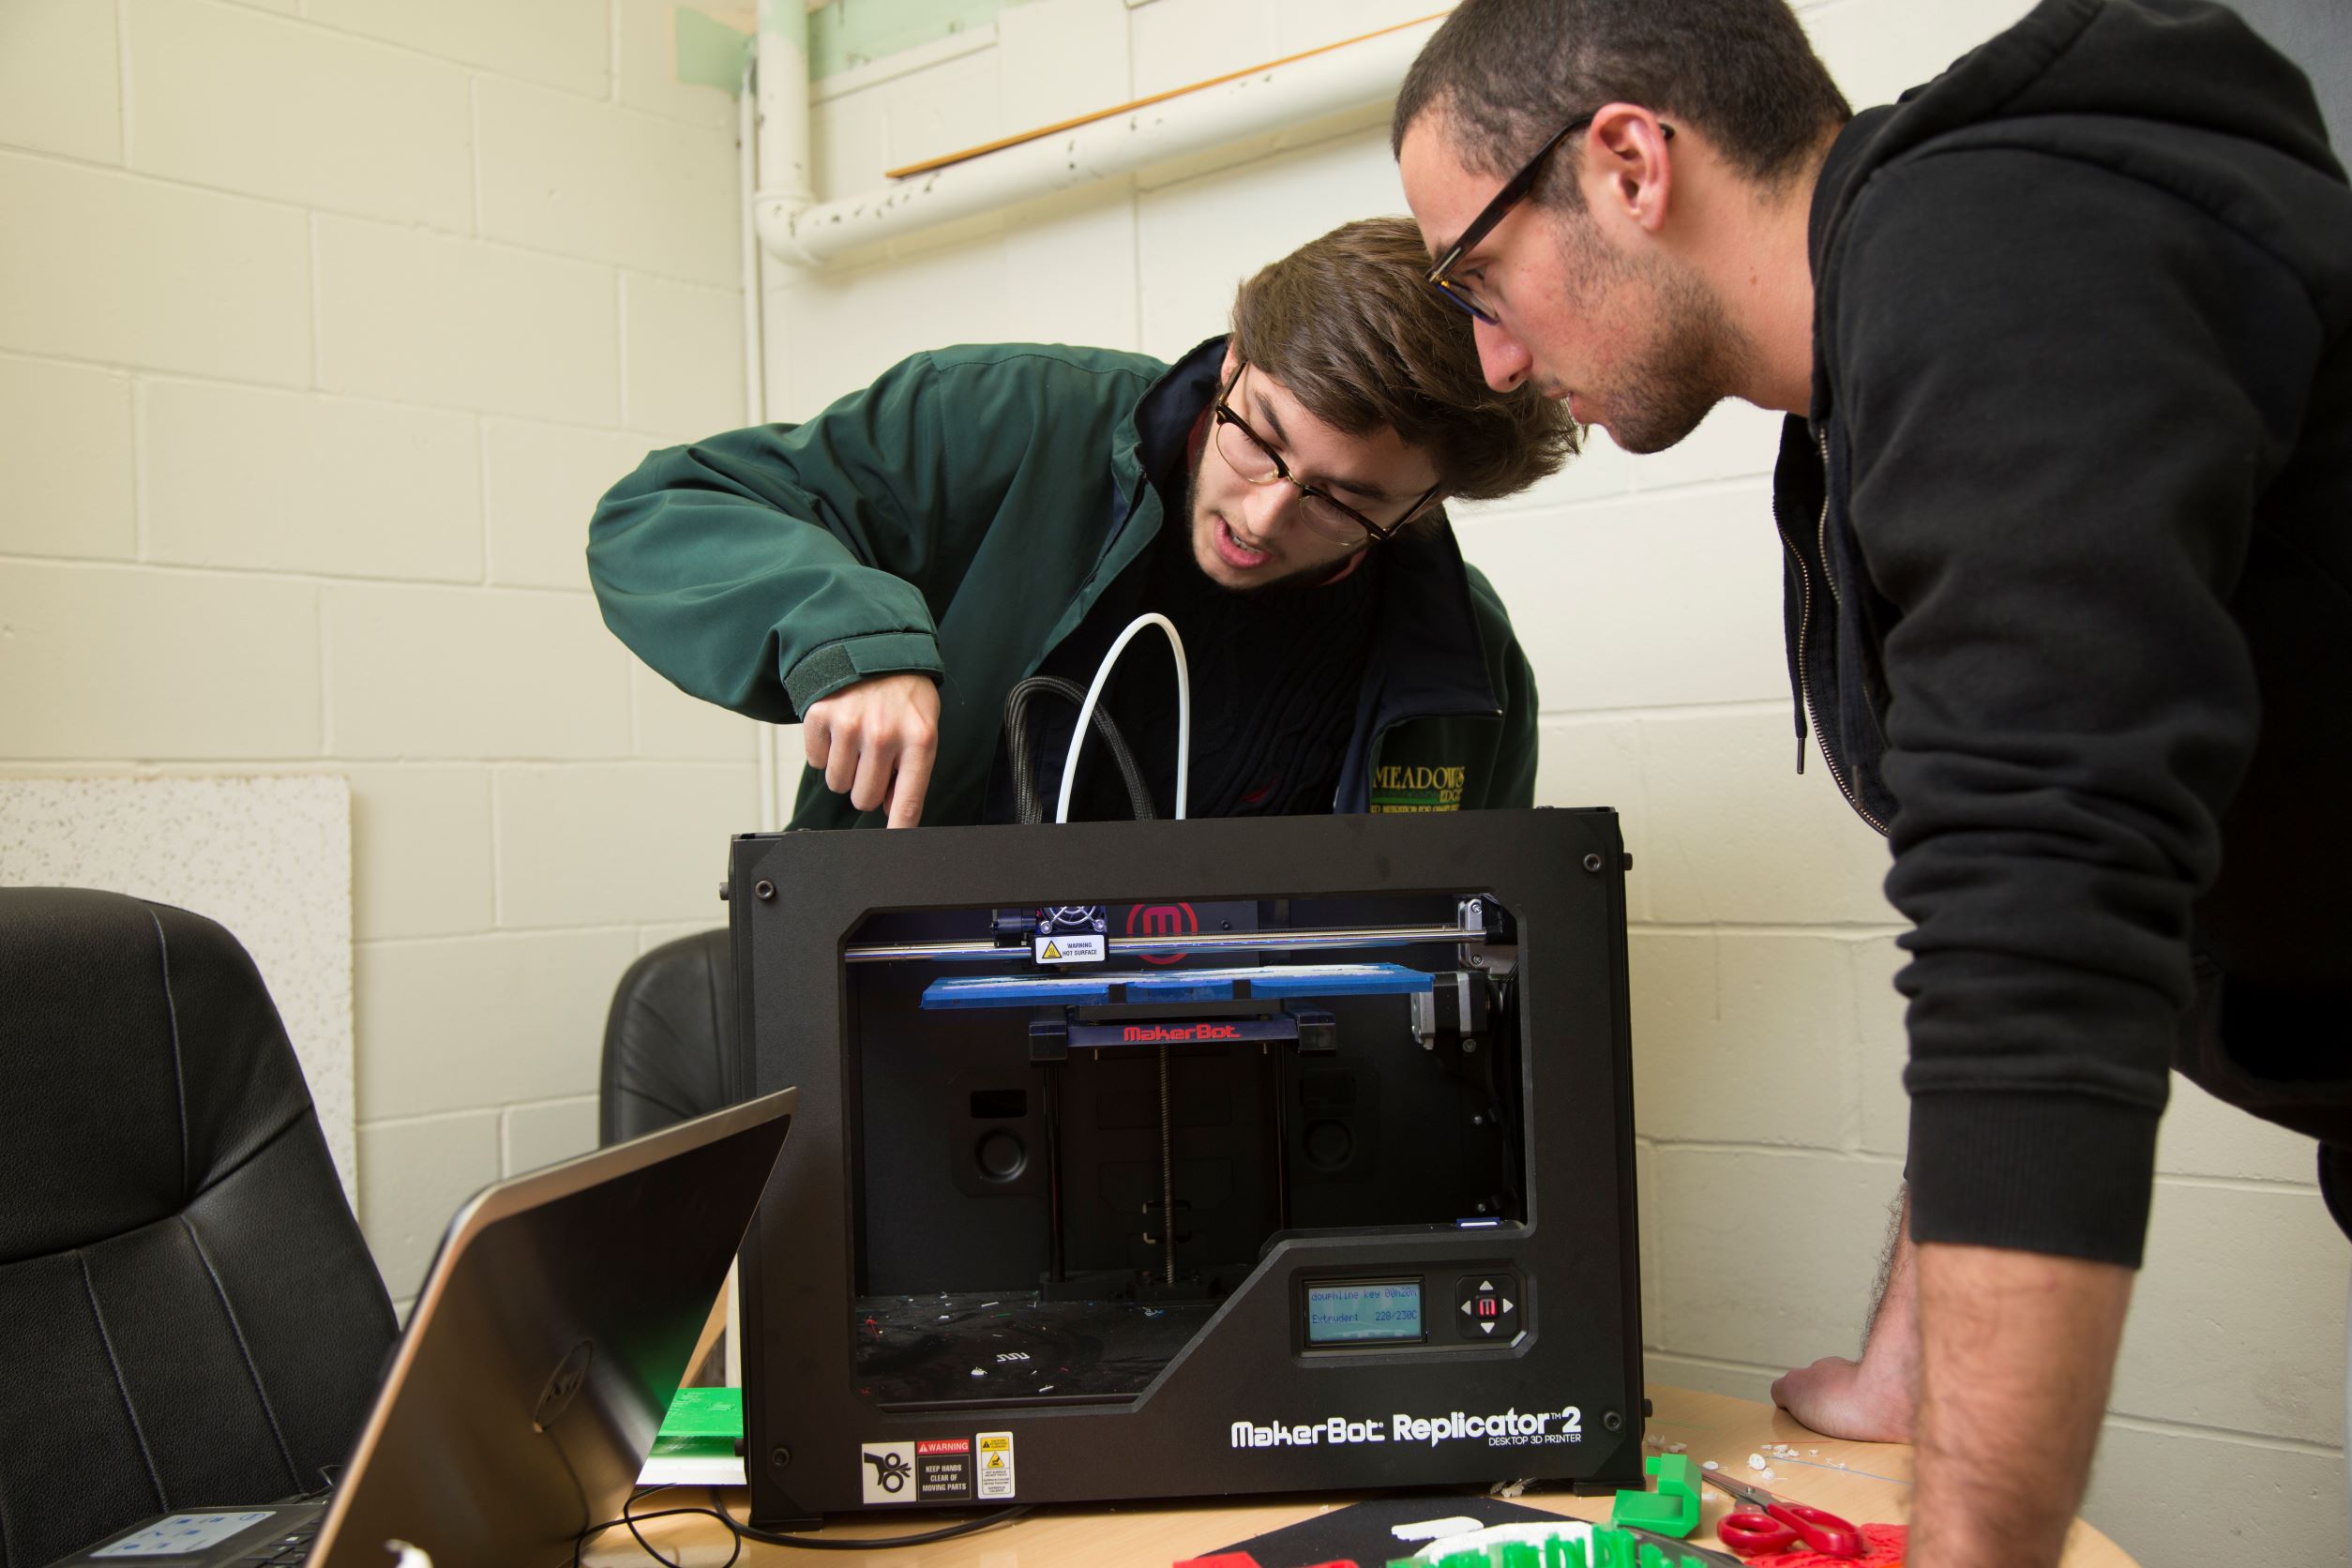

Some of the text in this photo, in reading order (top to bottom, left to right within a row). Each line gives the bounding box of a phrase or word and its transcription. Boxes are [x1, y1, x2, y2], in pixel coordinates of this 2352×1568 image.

[1123, 1023, 1242, 1042] MakerBot
[1312, 1310, 1417, 1324] Extruder: 228/230C
[1561, 1406, 1582, 1433] 2
[928, 1441, 969, 1453] WARNING
[1488, 1433, 1582, 1447] DESKTOP 3D PRINTER
[926, 1464, 962, 1473] KEEP HANDS
[923, 1484, 945, 1492] MOVING
